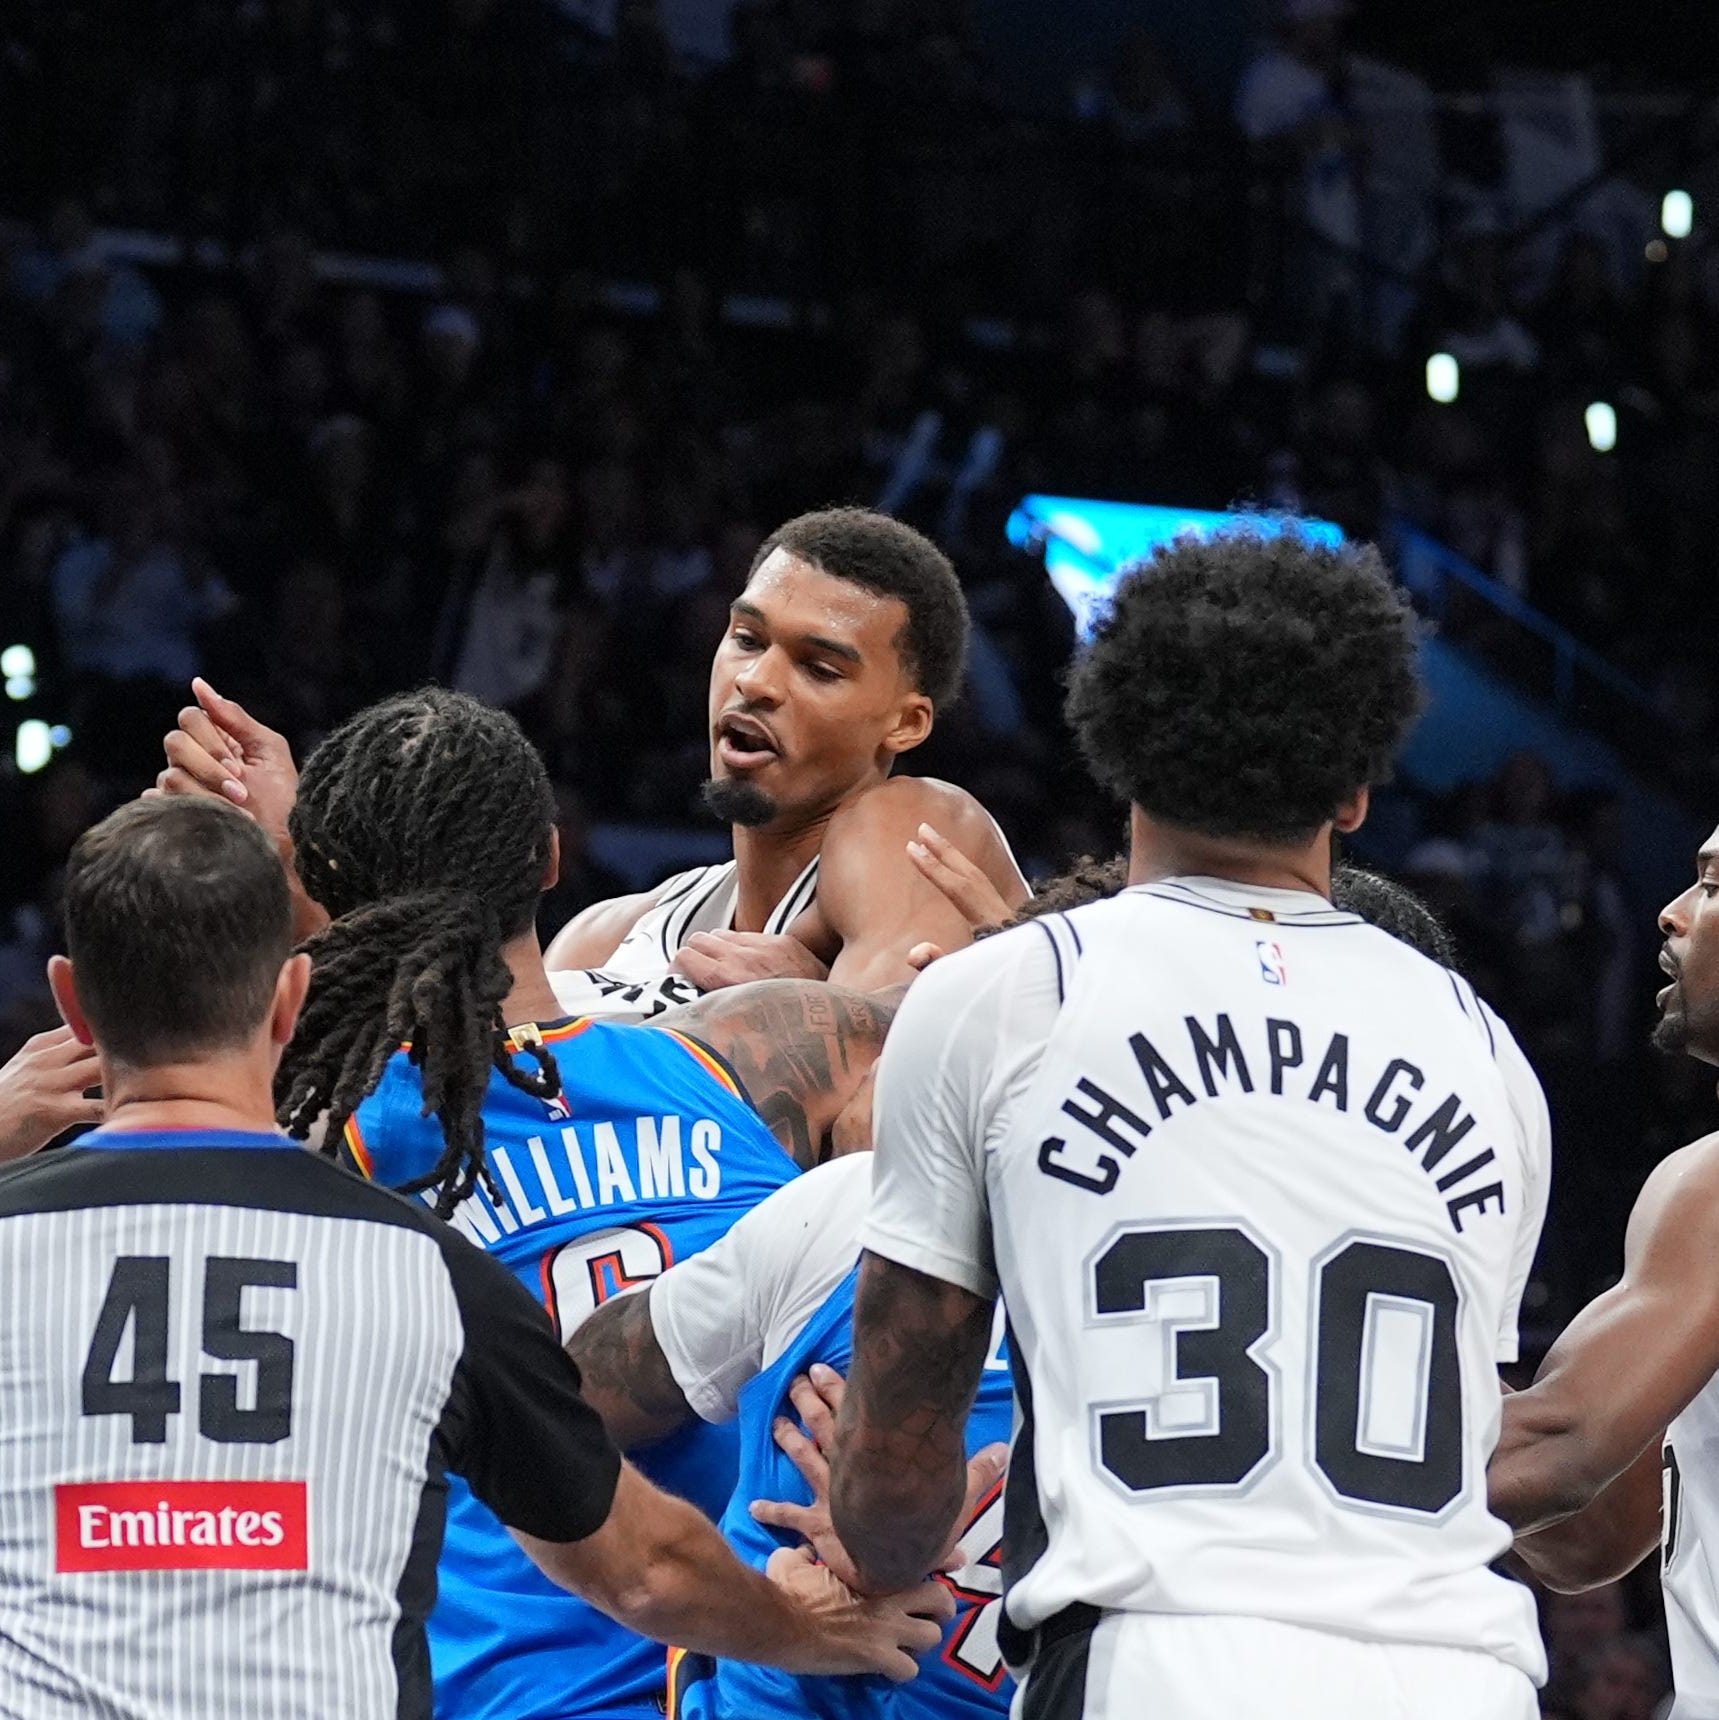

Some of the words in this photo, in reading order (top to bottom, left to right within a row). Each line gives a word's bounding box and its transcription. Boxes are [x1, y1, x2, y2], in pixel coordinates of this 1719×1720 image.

[1037, 1013, 1505, 1233] CHAMPAGNIE
[81, 1255, 297, 1443] 45
[1083, 1217, 1470, 1528] 30
[78, 1500, 285, 1549] Emirates
